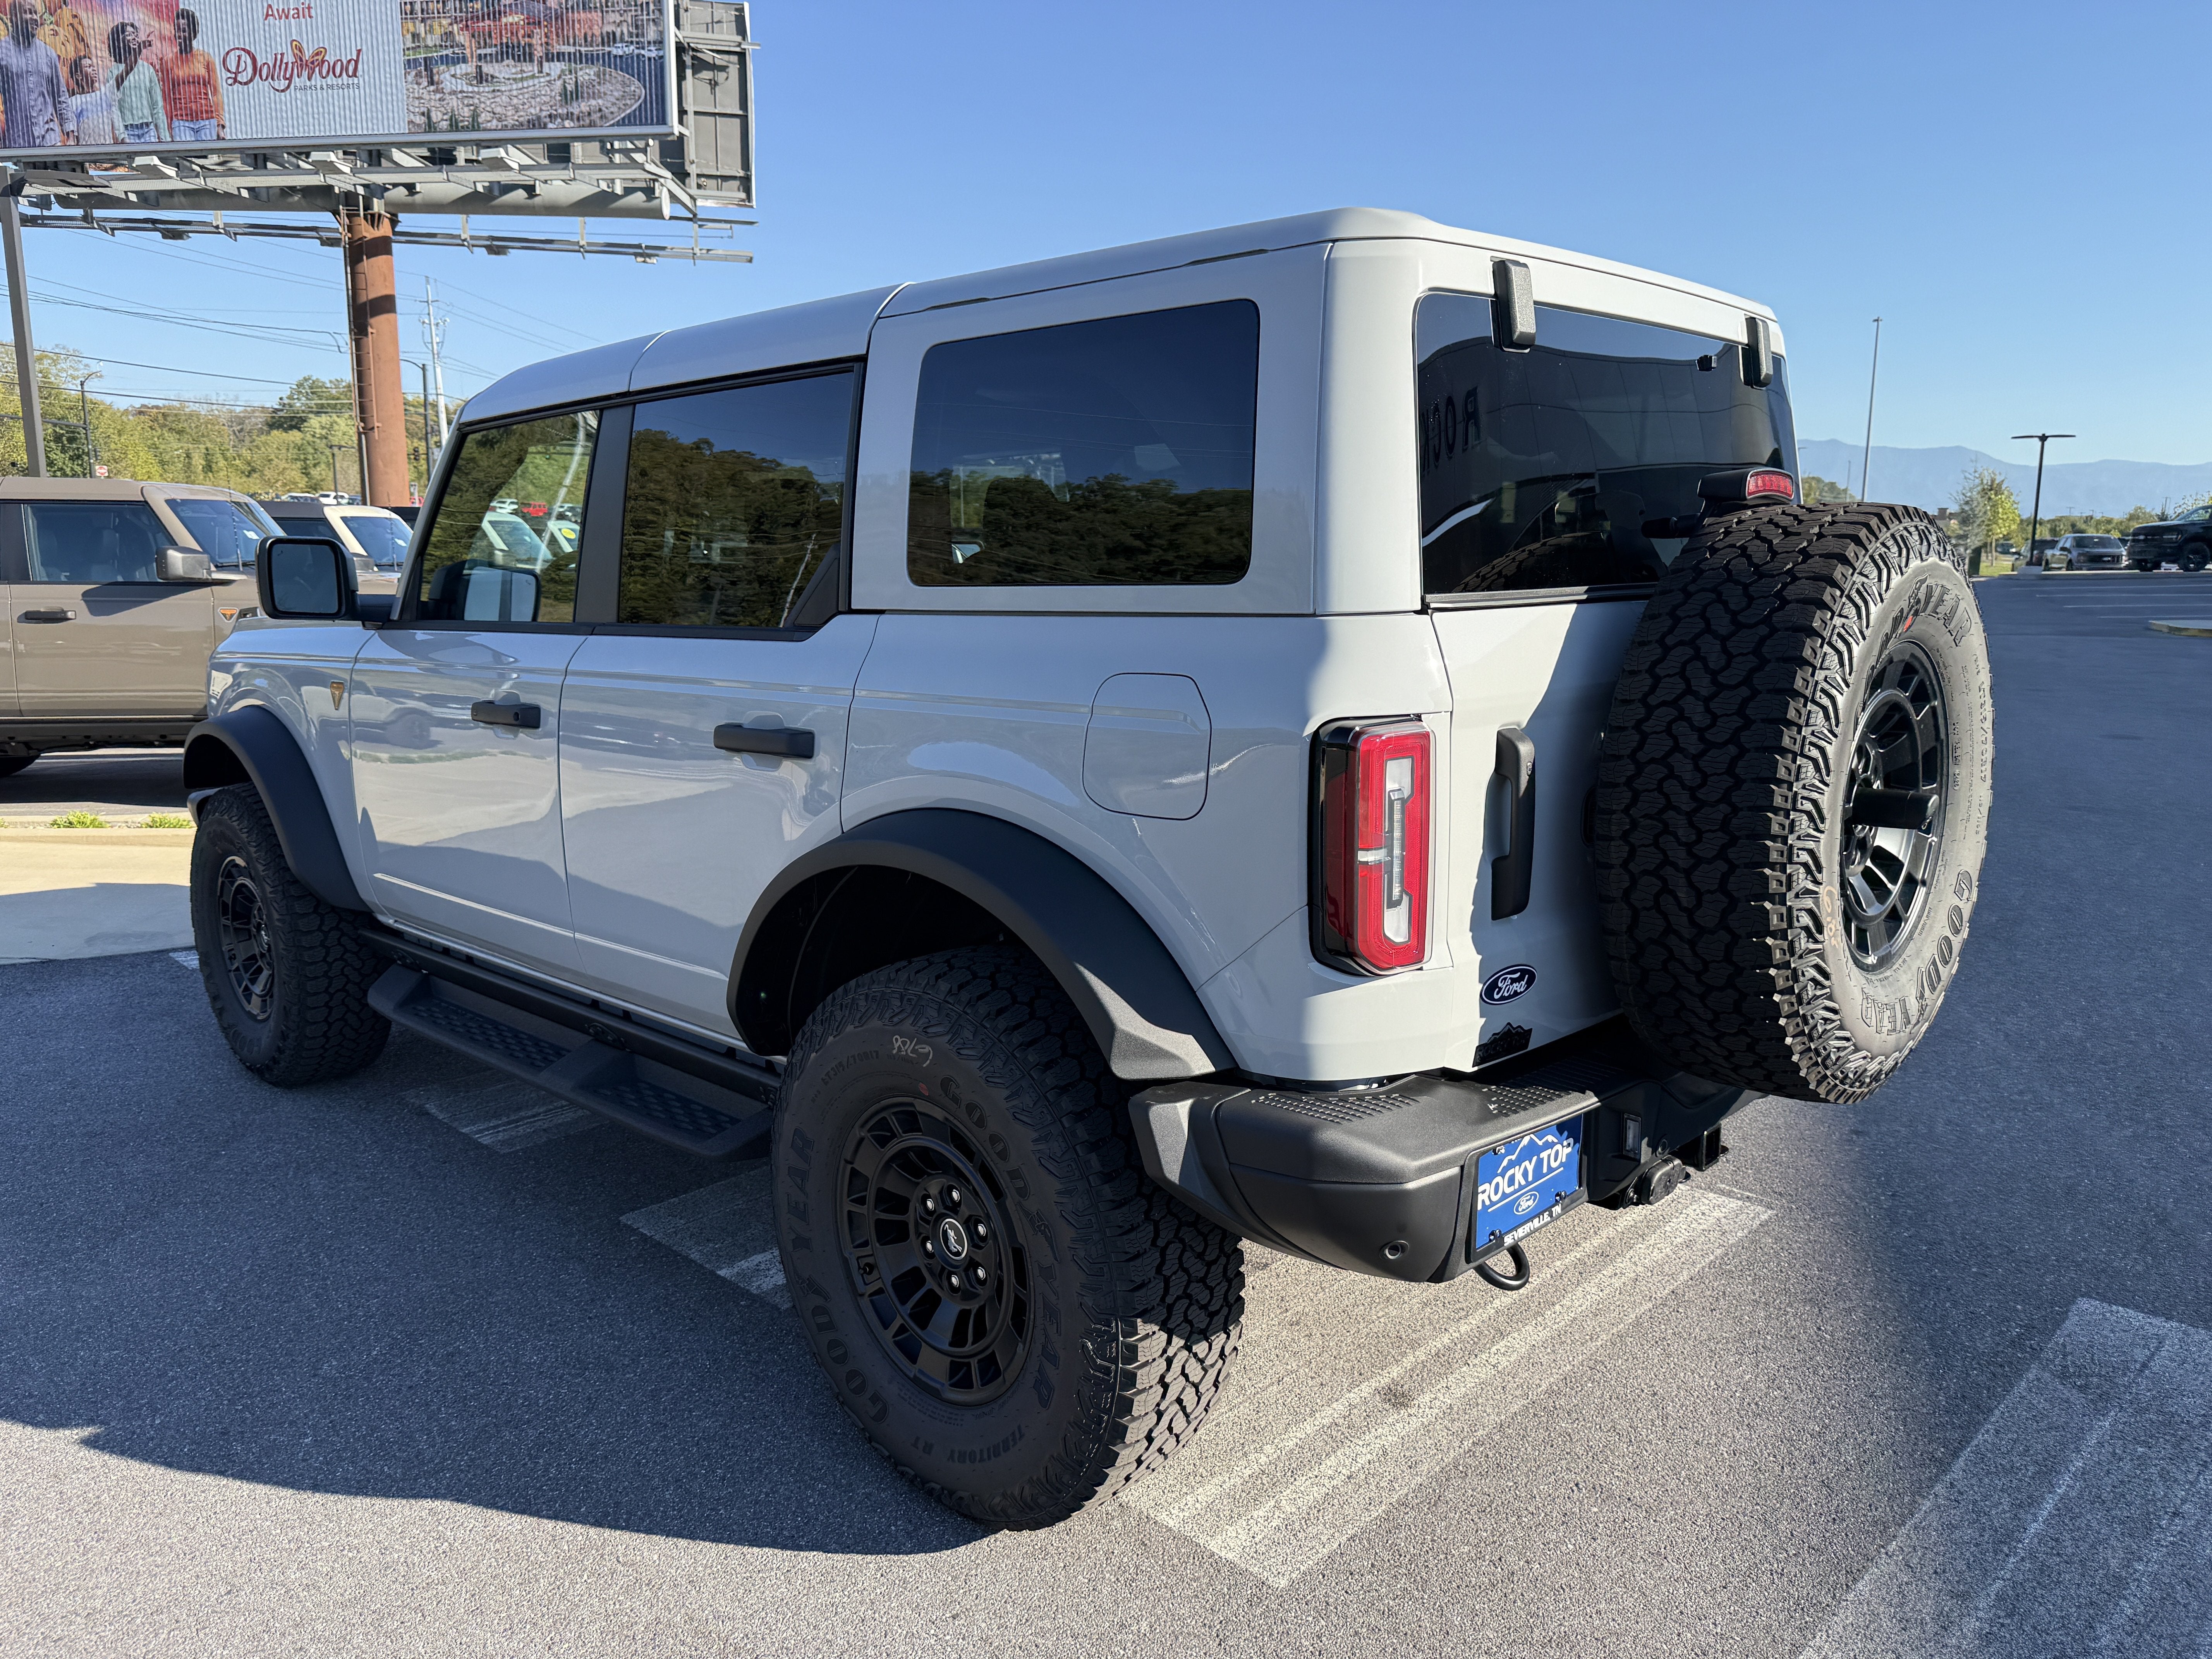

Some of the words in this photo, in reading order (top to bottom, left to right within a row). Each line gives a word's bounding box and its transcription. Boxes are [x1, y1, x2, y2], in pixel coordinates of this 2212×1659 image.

[264, 2, 313, 21] Await
[1862, 869, 1972, 1035] GOODYEAR
[1494, 972, 1528, 999] Ford
[1477, 1156, 1537, 1210] ROCKY
[1540, 1138, 1573, 1173] TOP
[1518, 1195, 1534, 1212] Ford
[940, 1075, 1061, 1410] GOODYEAR
[1504, 1212, 1551, 1246] SEVIERVILLE,
[1552, 1204, 1561, 1217] TN
[787, 1127, 889, 1423] GOODYEAR
[911, 1436, 934, 1455] RT
[947, 1424, 1025, 1464] TERRITORY
